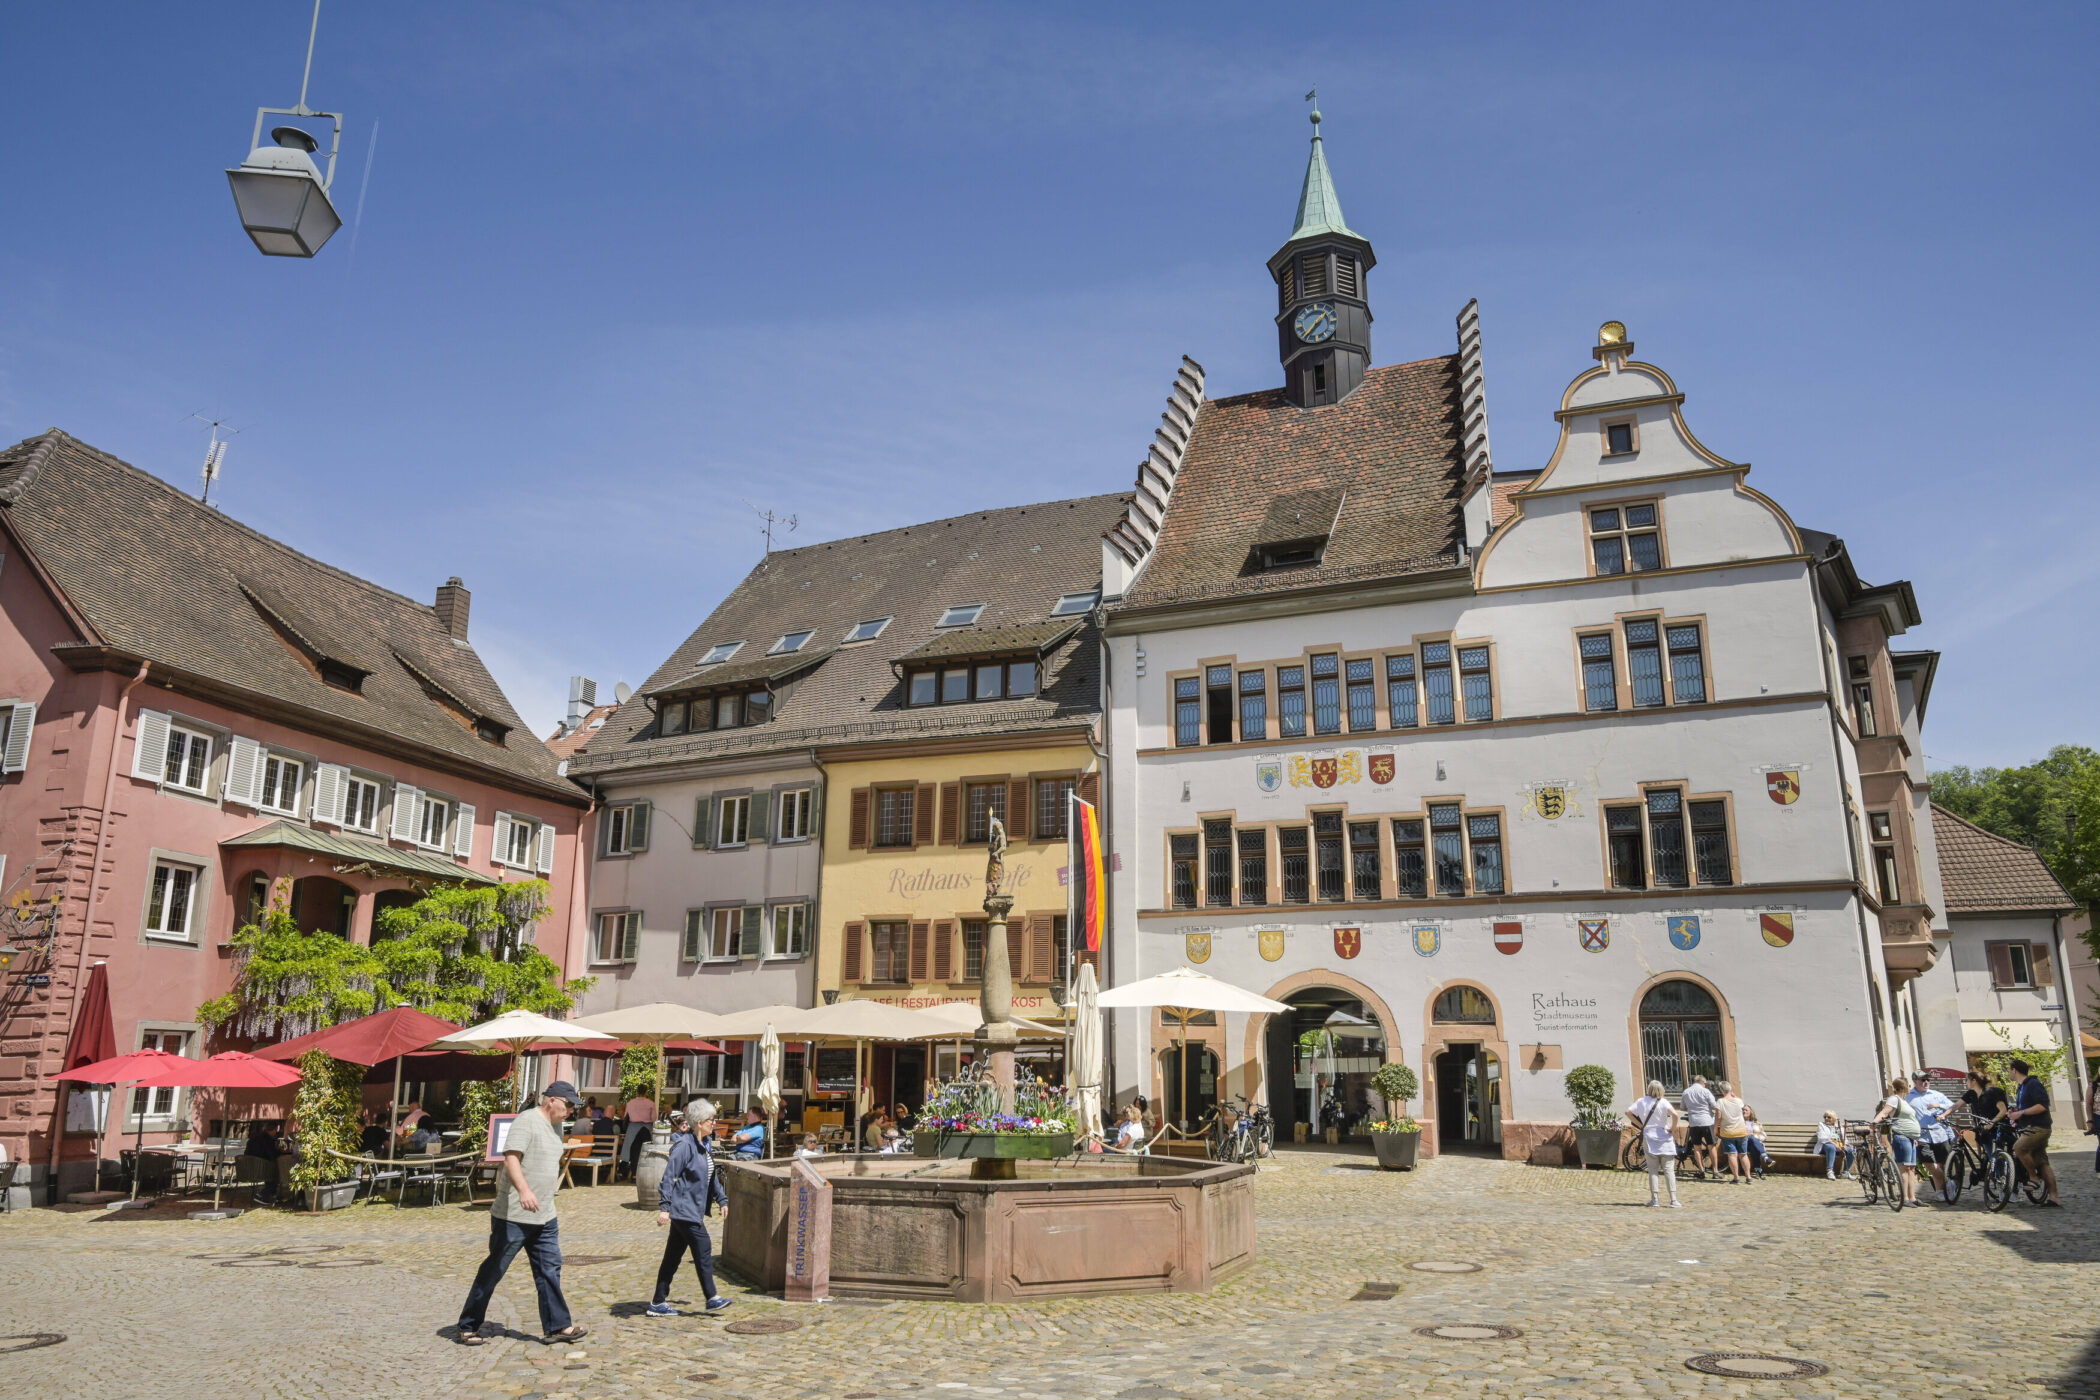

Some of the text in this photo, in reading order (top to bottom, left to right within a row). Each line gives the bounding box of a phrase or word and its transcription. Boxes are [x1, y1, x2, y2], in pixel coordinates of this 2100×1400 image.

[887, 864, 1033, 899] Rathaus-afé
[1011, 996, 1044, 1008] KOST
[1532, 992, 1597, 1009] Rathaus
[1533, 1010, 1598, 1021] Stadtmuseum
